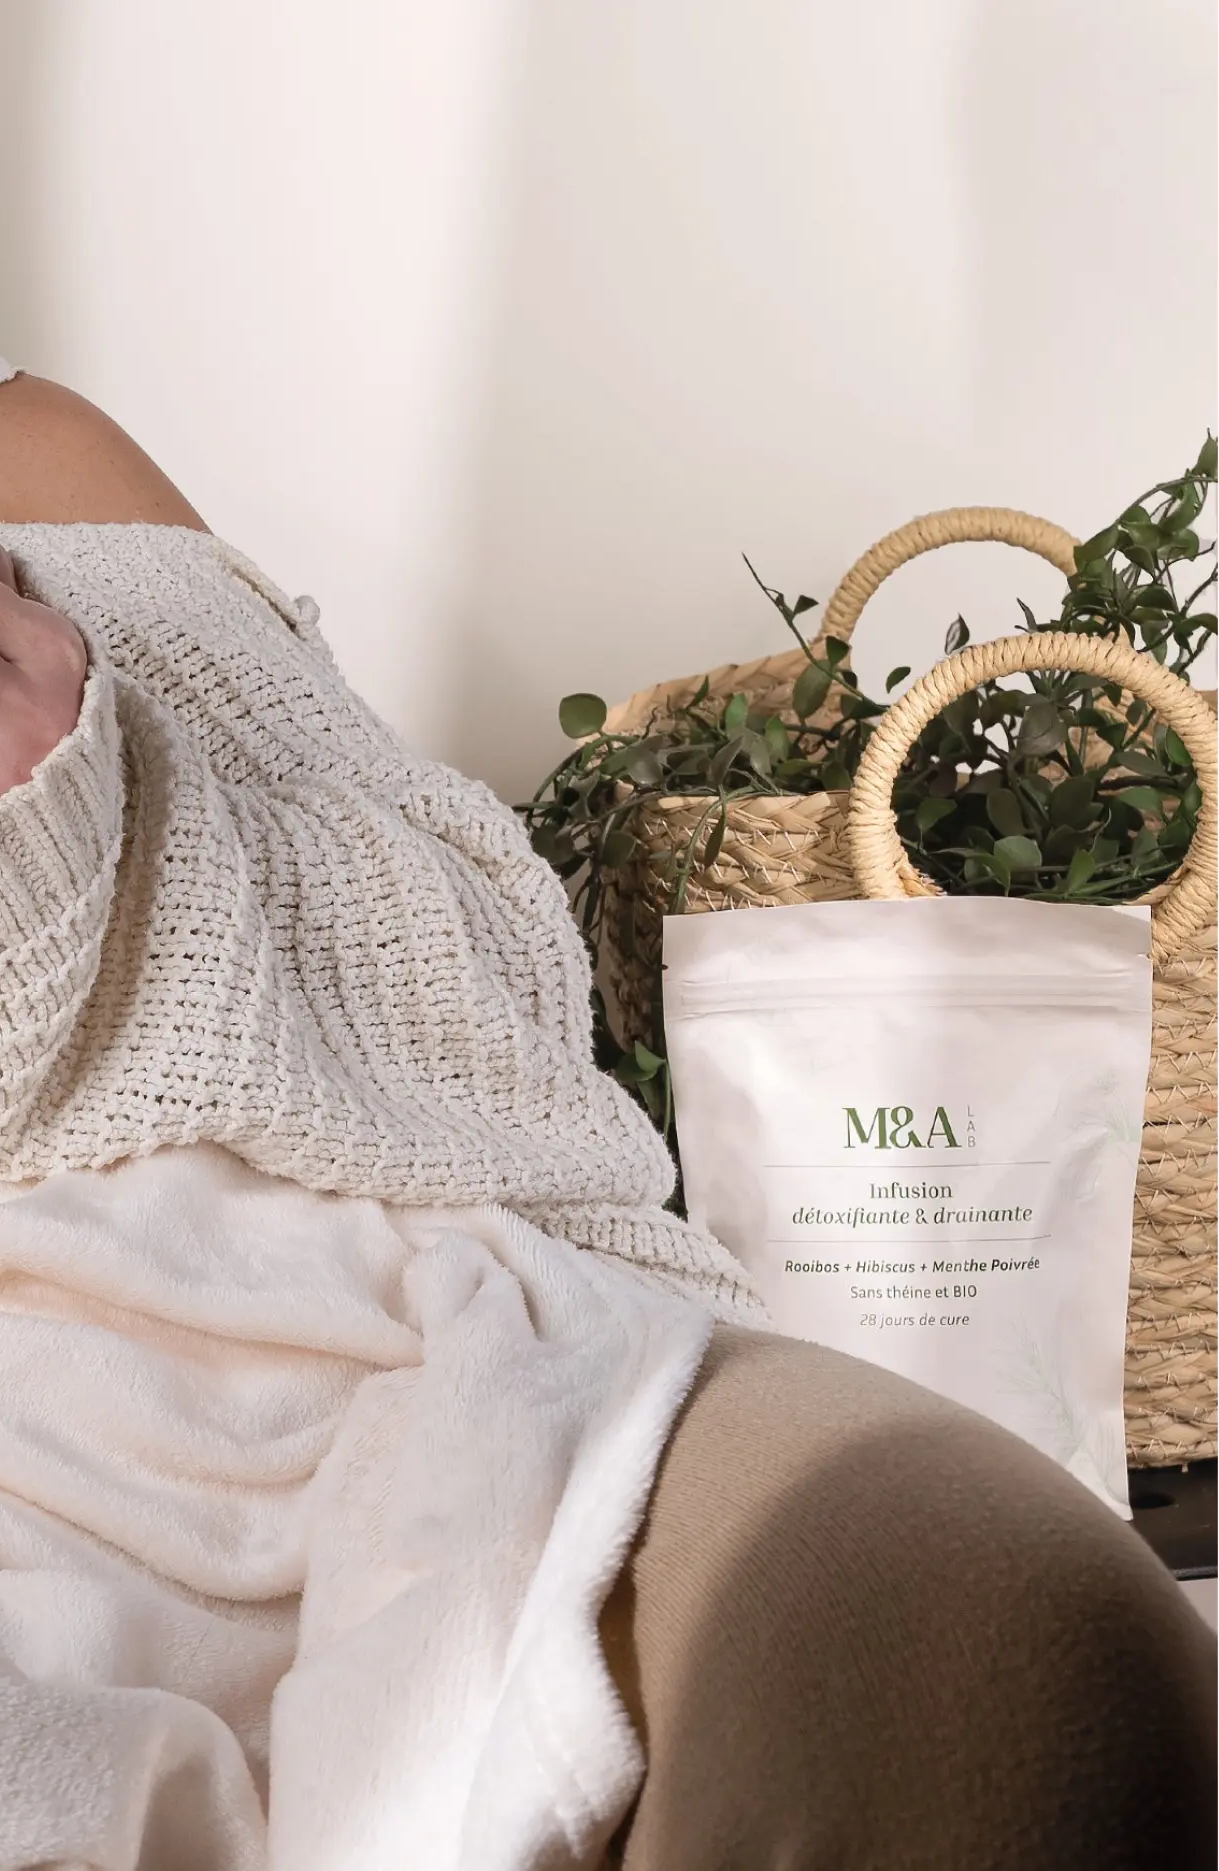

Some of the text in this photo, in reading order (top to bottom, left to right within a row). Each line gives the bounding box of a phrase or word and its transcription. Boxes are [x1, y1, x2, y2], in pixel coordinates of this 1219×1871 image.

[842, 1106, 963, 1150] M&A
[967, 1105, 976, 1148] LAB
[869, 1182, 954, 1199] Infusion
[792, 1206, 1032, 1228] détoxifiante & drainante
[785, 1257, 1040, 1273] Rooibos + Hibiscus + Menthe Poivrée
[851, 1285, 977, 1299] Sans théine et BIO
[860, 1312, 969, 1329] 28 jours de cure
